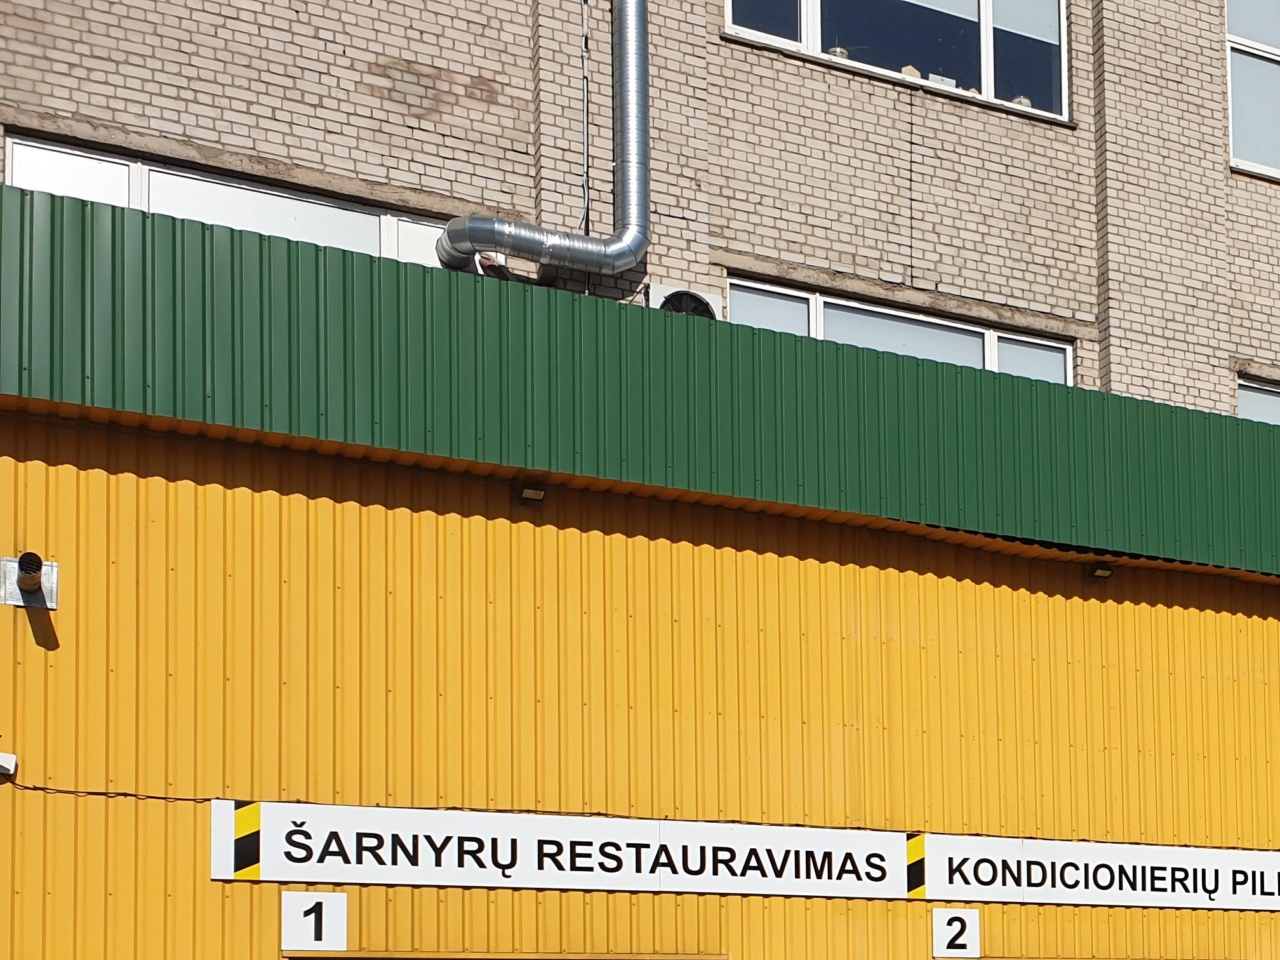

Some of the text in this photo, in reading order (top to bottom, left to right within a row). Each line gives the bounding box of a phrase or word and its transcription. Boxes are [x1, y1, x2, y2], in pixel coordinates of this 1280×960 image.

[283, 821, 888, 883] ŠARNYRŲ RESTAURAVIMAS
[946, 856, 1220, 902] KONDICIONIERIŲ
[302, 901, 324, 942] 1
[945, 916, 968, 950] 2
